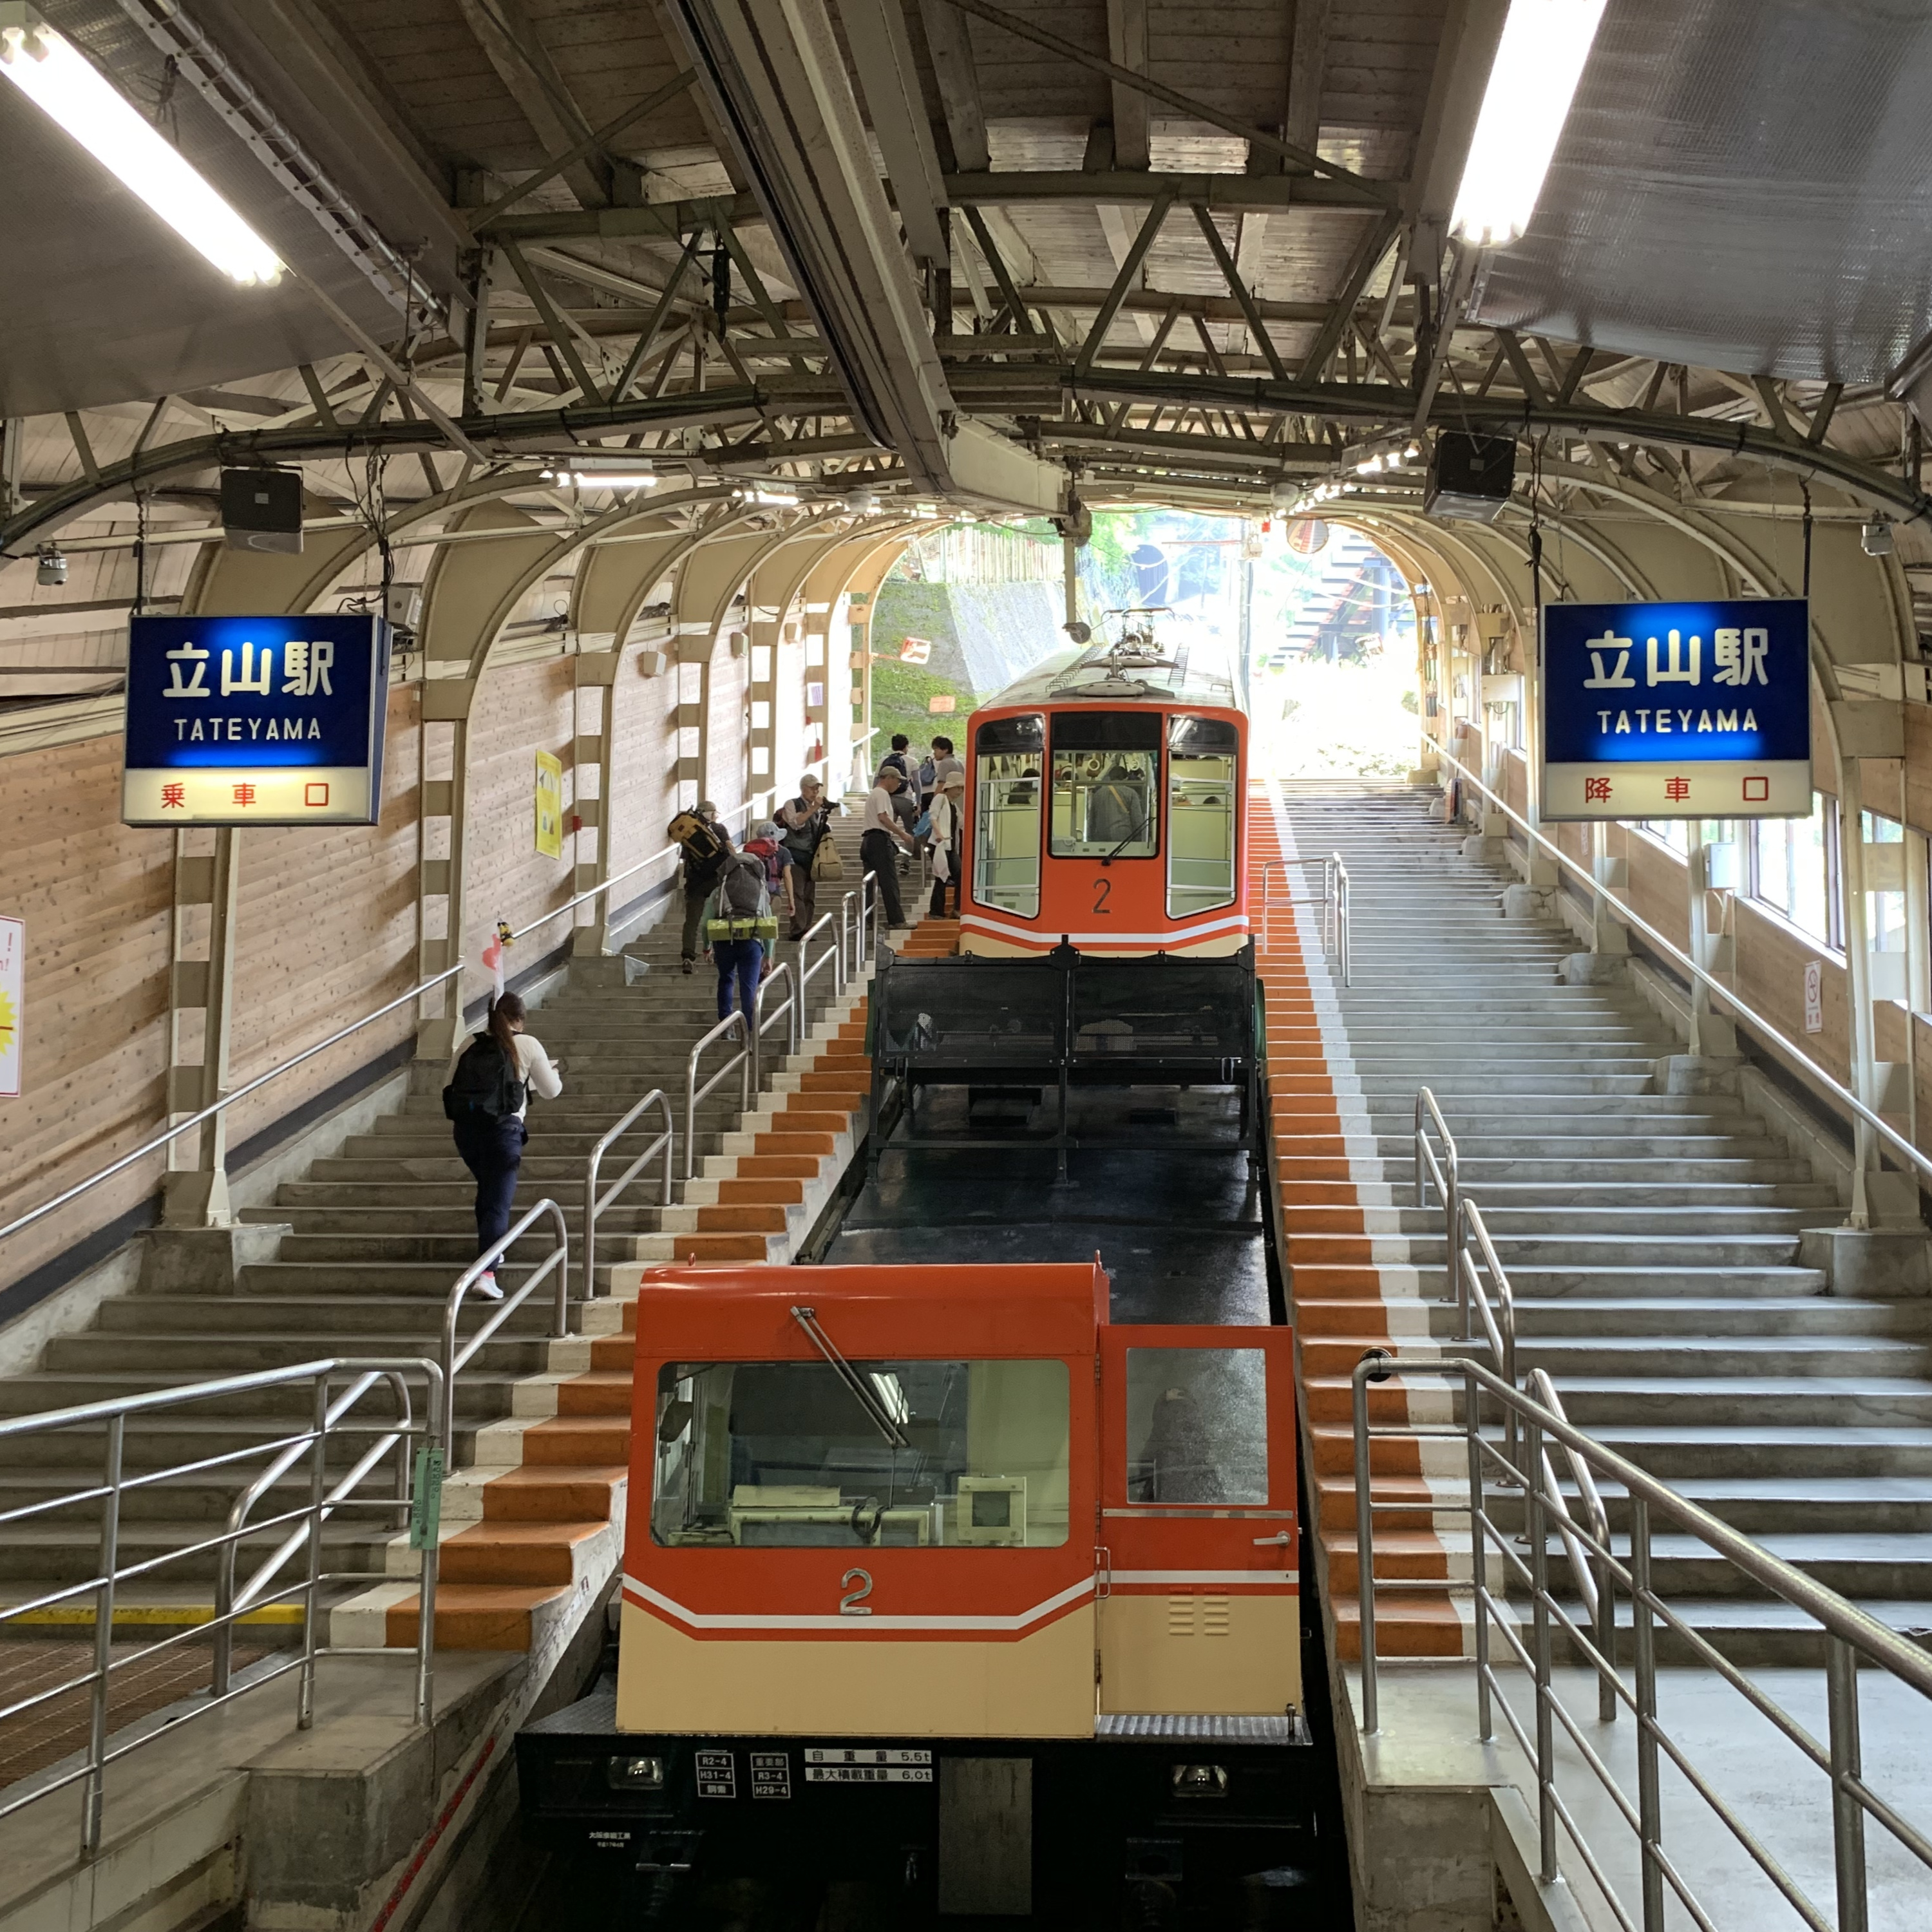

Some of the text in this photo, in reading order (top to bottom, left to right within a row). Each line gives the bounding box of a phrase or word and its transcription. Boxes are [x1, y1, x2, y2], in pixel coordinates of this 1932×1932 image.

[162, 641, 334, 697] 立山駅
[1583, 628, 1769, 688] 立山駅
[174, 717, 321, 741] TATEYAMA
[1596, 708, 1758, 734] TATEYAMA
[161, 782, 329, 809] 乗車口
[1585, 776, 1769, 804] 降車口
[1092, 878, 1112, 914] 2
[840, 1567, 873, 1615] 2
[702, 1757, 727, 1766] R2-4
[812, 1750, 887, 1762] 自重量
[700, 1771, 732, 1779] H31-4
[757, 1772, 783, 1781] R3-4
[813, 1768, 931, 1781] 最大積載重量 6.0t
